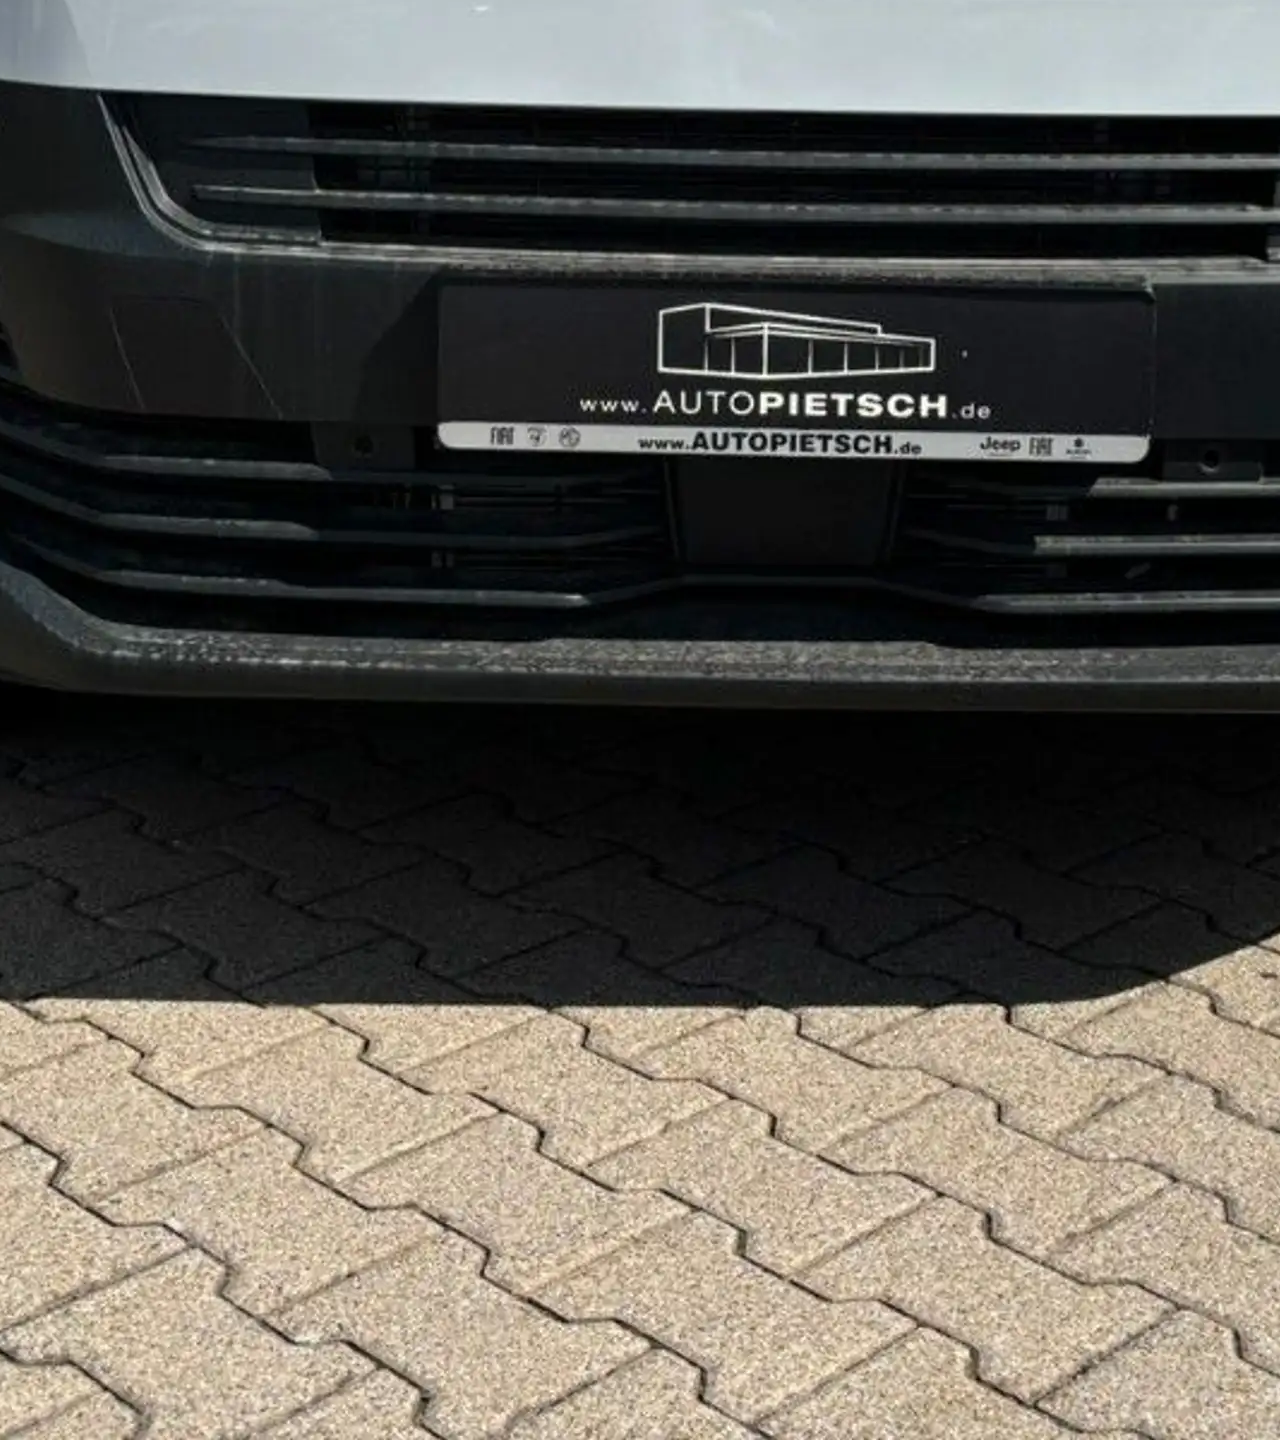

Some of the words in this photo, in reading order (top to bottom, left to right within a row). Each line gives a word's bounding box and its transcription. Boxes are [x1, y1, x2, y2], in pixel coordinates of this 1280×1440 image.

[579, 389, 992, 420] www.AUTOPIETSCH.de
[637, 431, 922, 456] www.AUTOPIETSCH.de
[980, 436, 1021, 452] Jeep
